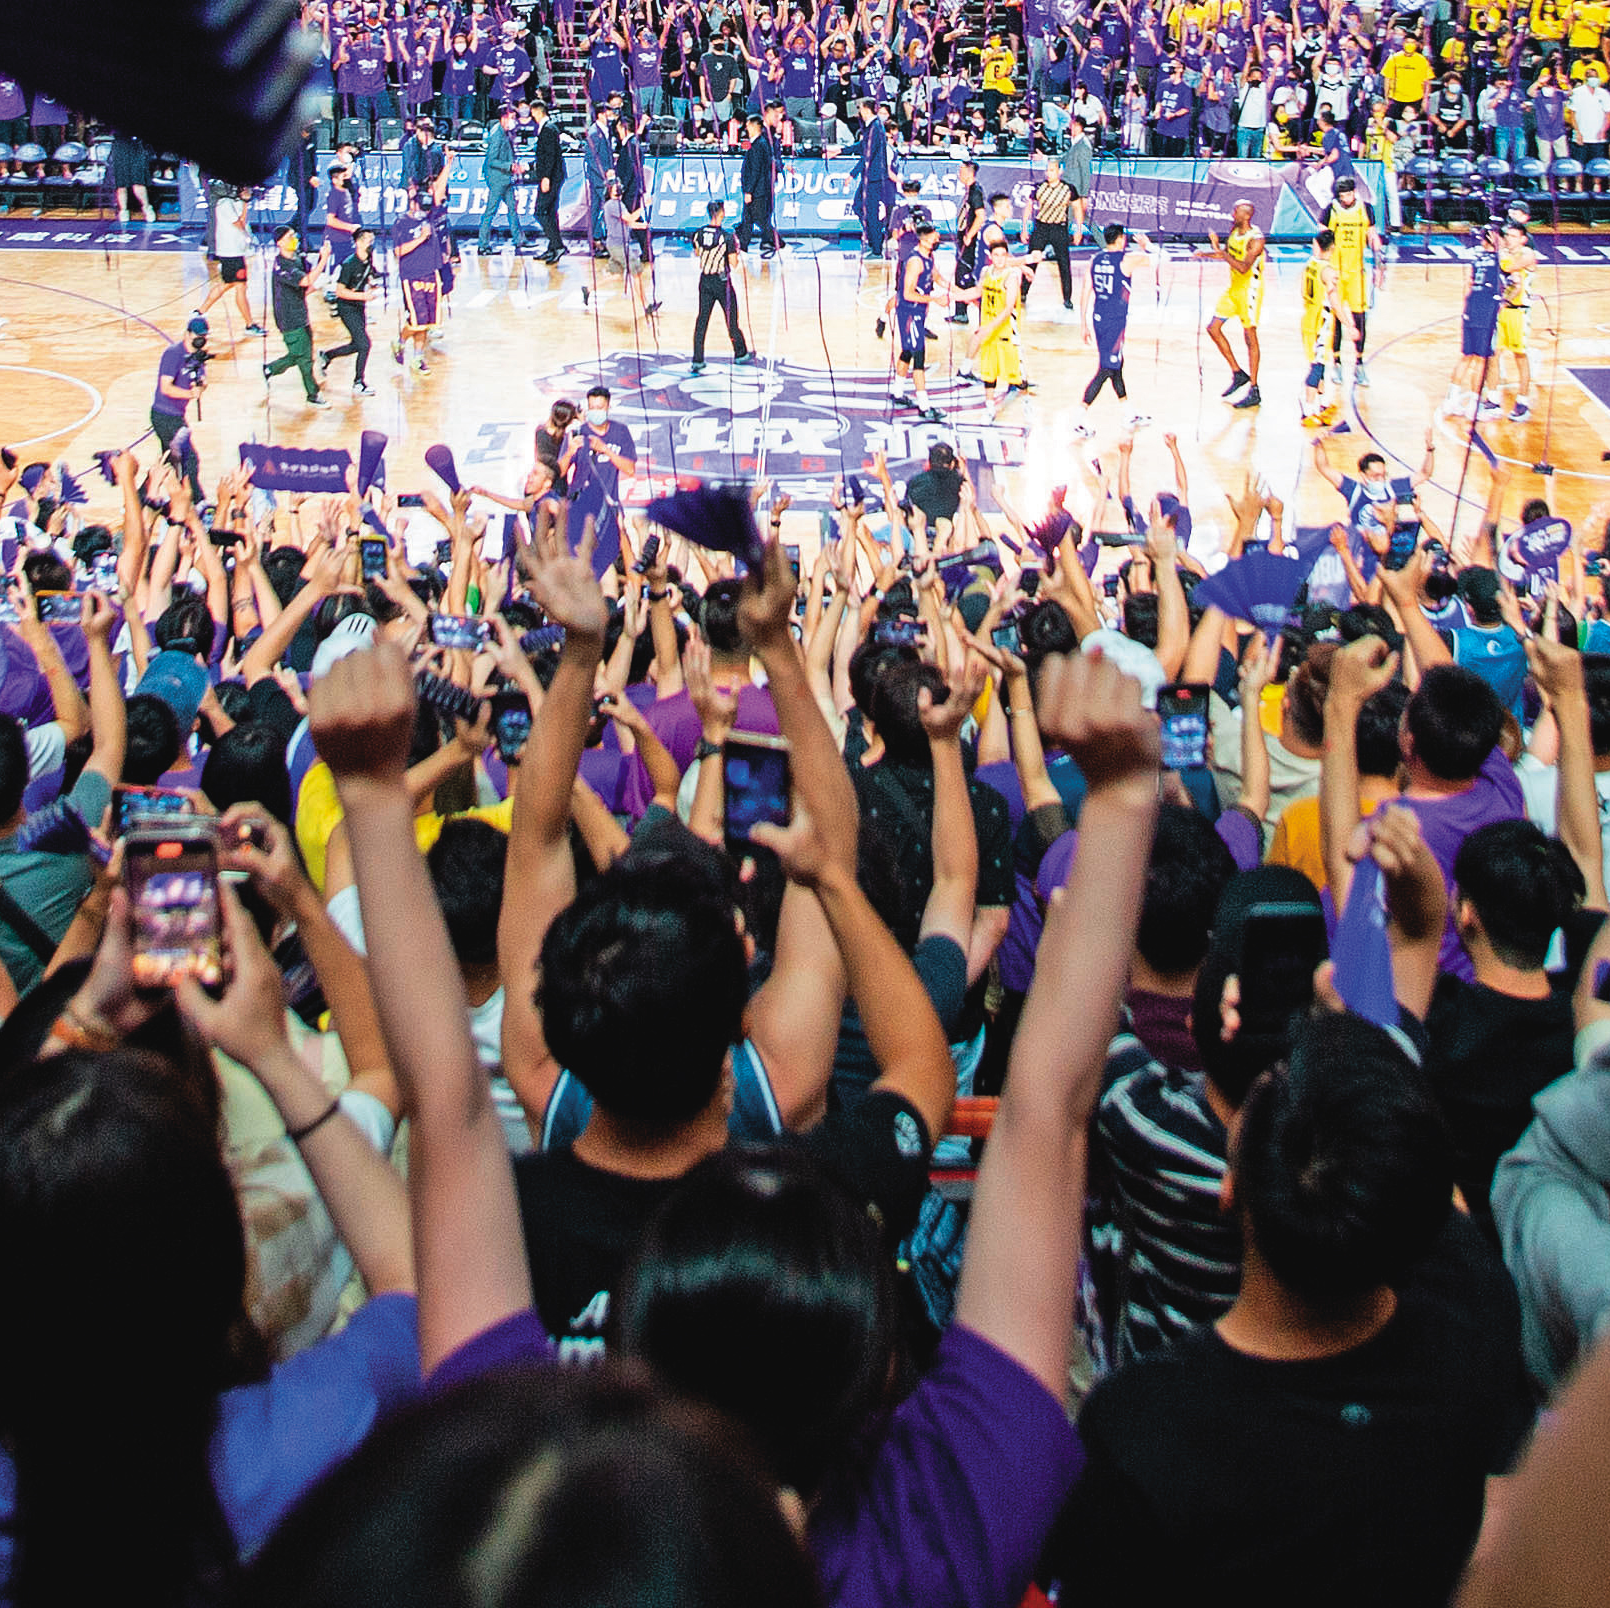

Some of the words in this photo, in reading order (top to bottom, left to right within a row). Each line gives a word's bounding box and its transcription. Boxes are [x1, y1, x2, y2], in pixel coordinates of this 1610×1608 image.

[660, 171, 728, 193] NEW
[730, 171, 853, 194] PODUCT
[1093, 275, 1114, 295] 54
